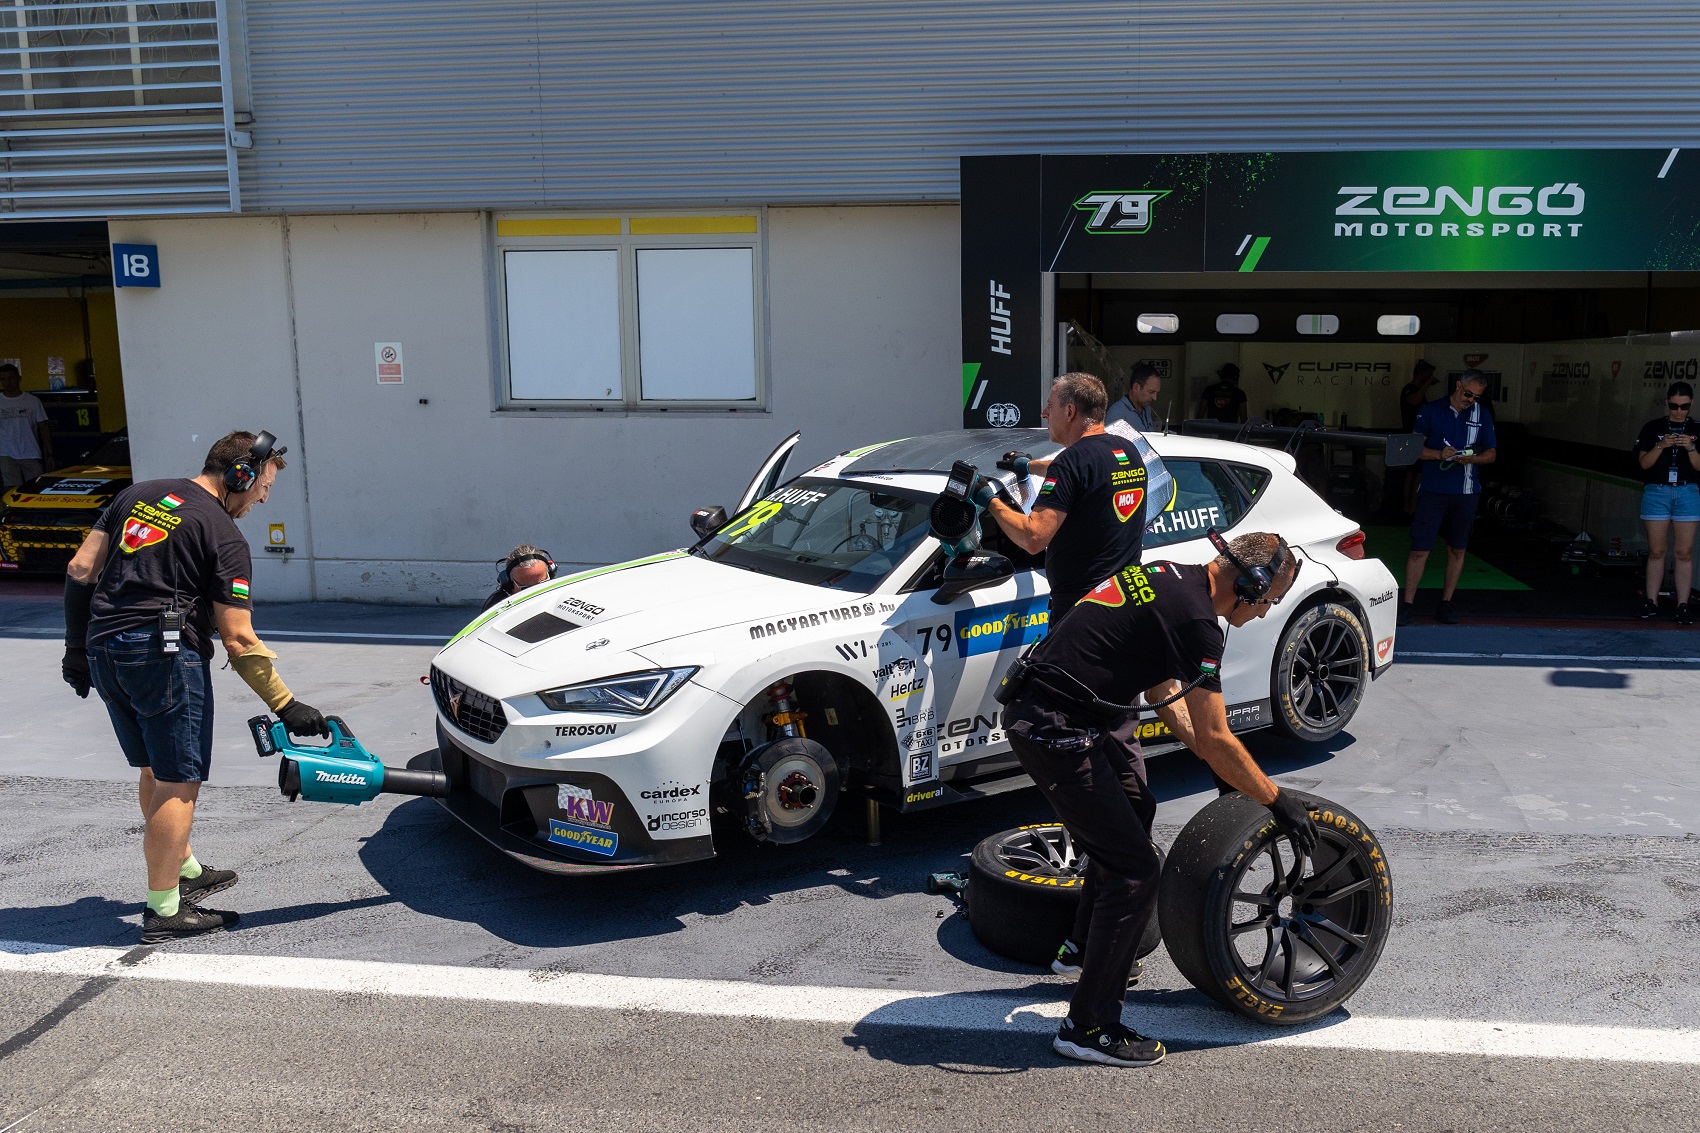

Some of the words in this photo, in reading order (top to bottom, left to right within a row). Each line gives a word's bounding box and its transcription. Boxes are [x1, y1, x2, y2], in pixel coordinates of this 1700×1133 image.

[1077, 193, 1158, 229] 79
[1334, 222, 1584, 237] MOTORSPORT
[122, 253, 150, 278] 18
[989, 279, 1012, 355] HUFF
[1298, 362, 1391, 372] CUPRA
[1297, 375, 1391, 387] RACING
[76, 407, 90, 427] 13
[1112, 477, 1146, 487] MOTORSPORT
[61, 496, 92, 504] Sport
[1118, 494, 1135, 508] MOL
[131, 509, 177, 531] MOTORSPORT
[717, 500, 784, 537] 79
[1152, 507, 1220, 535] R.HUFF
[557, 604, 595, 622] MOTORSPORT
[916, 624, 952, 656] 79
[890, 677, 924, 698] Hertz
[911, 710, 935, 725] BRB
[1230, 713, 1260, 727] CING
[1281, 693, 1303, 731] EAGLE
[555, 724, 618, 736] TEROSON
[916, 738, 933, 748] TAXI
[912, 755, 929, 773] BZ
[640, 784, 701, 799] cardex
[906, 786, 944, 803] driveral
[567, 795, 615, 825] KW
[1225, 976, 1284, 1018] EAGLE
